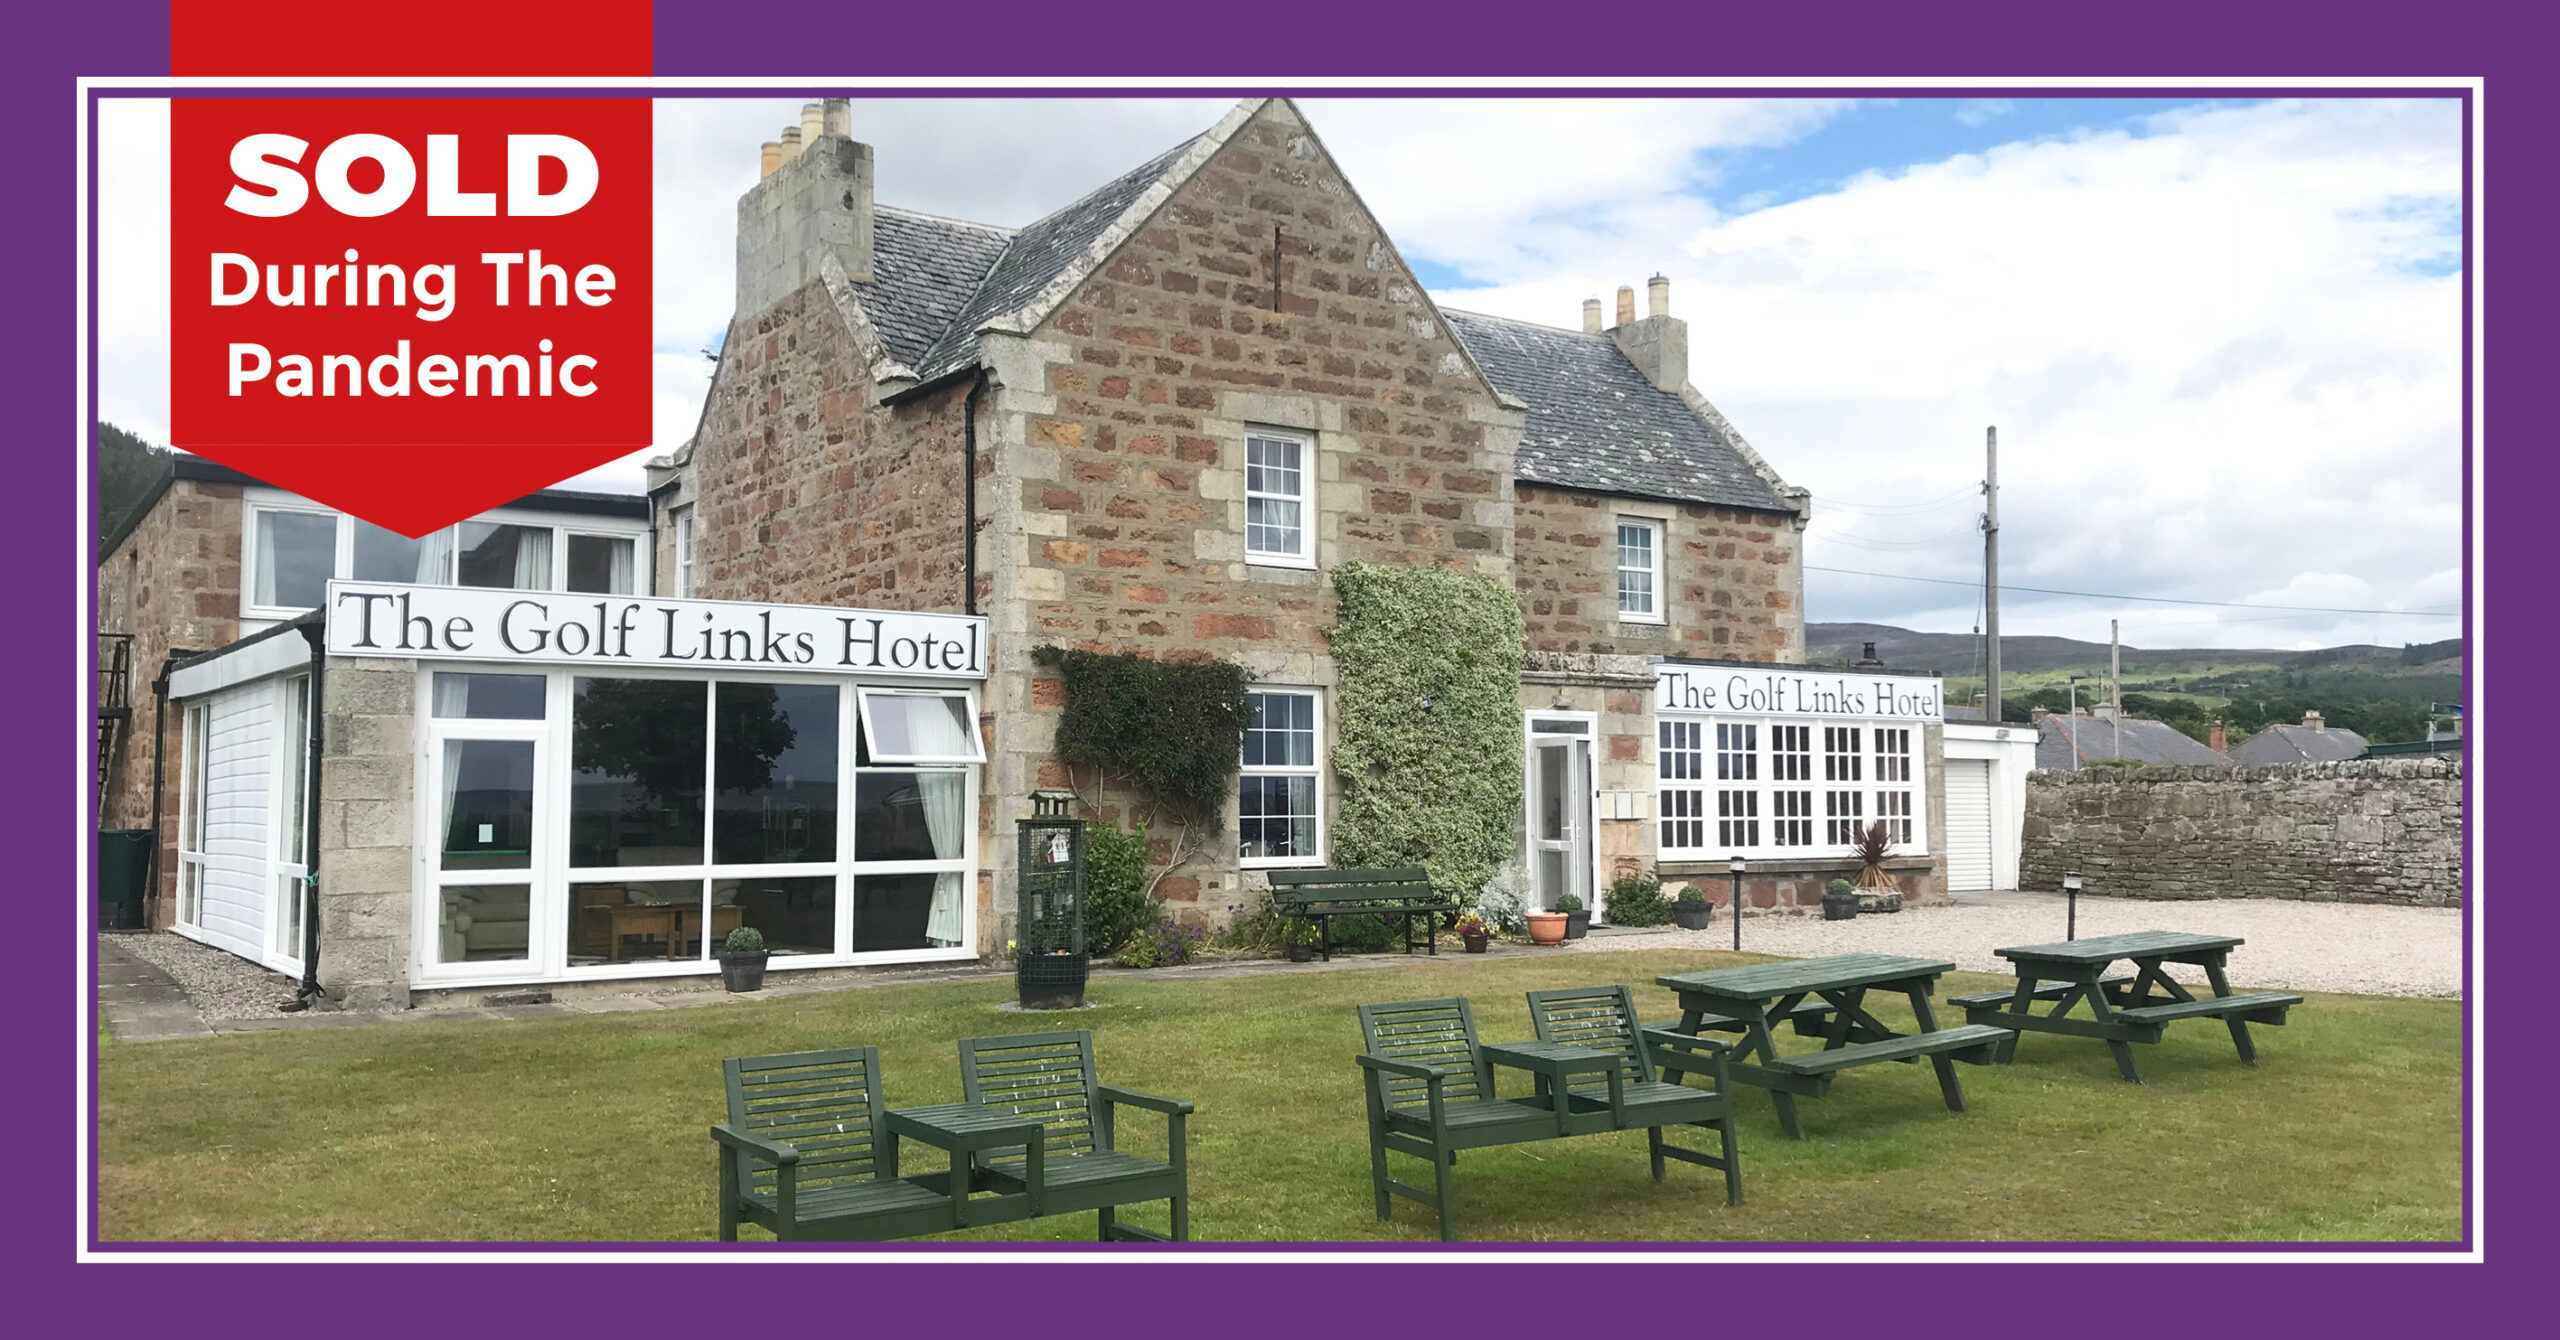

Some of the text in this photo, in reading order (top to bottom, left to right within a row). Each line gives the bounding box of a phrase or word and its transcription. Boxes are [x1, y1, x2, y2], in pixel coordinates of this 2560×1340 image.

[338, 592, 982, 673] The Golf Links Hotel
[1658, 672, 1939, 716] The Golf Links Hotel
